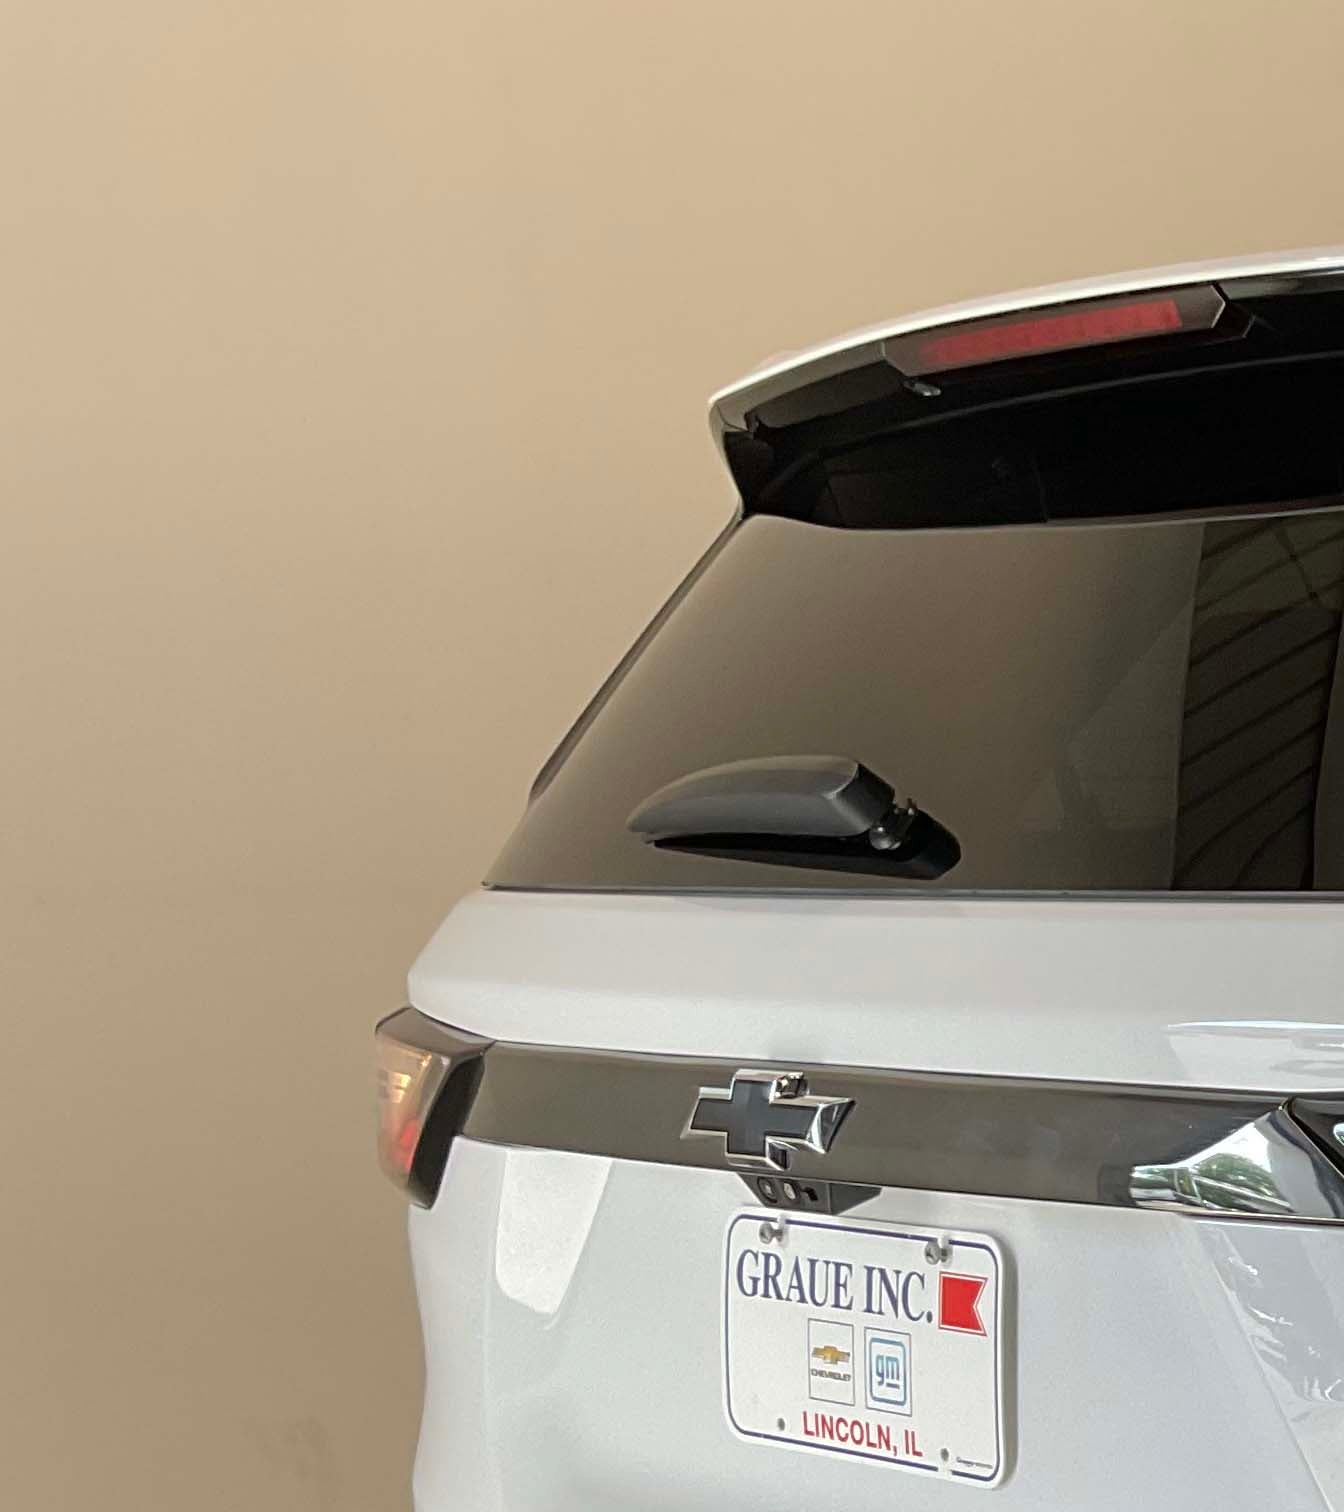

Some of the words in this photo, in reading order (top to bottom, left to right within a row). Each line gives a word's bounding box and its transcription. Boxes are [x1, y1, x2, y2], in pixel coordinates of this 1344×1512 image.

[736, 1249, 854, 1311] GRAUE
[863, 1265, 934, 1324] INC.
[875, 1353, 901, 1387] gm
[802, 1410, 898, 1457] LINCOLN,
[904, 1429, 924, 1457] IL
